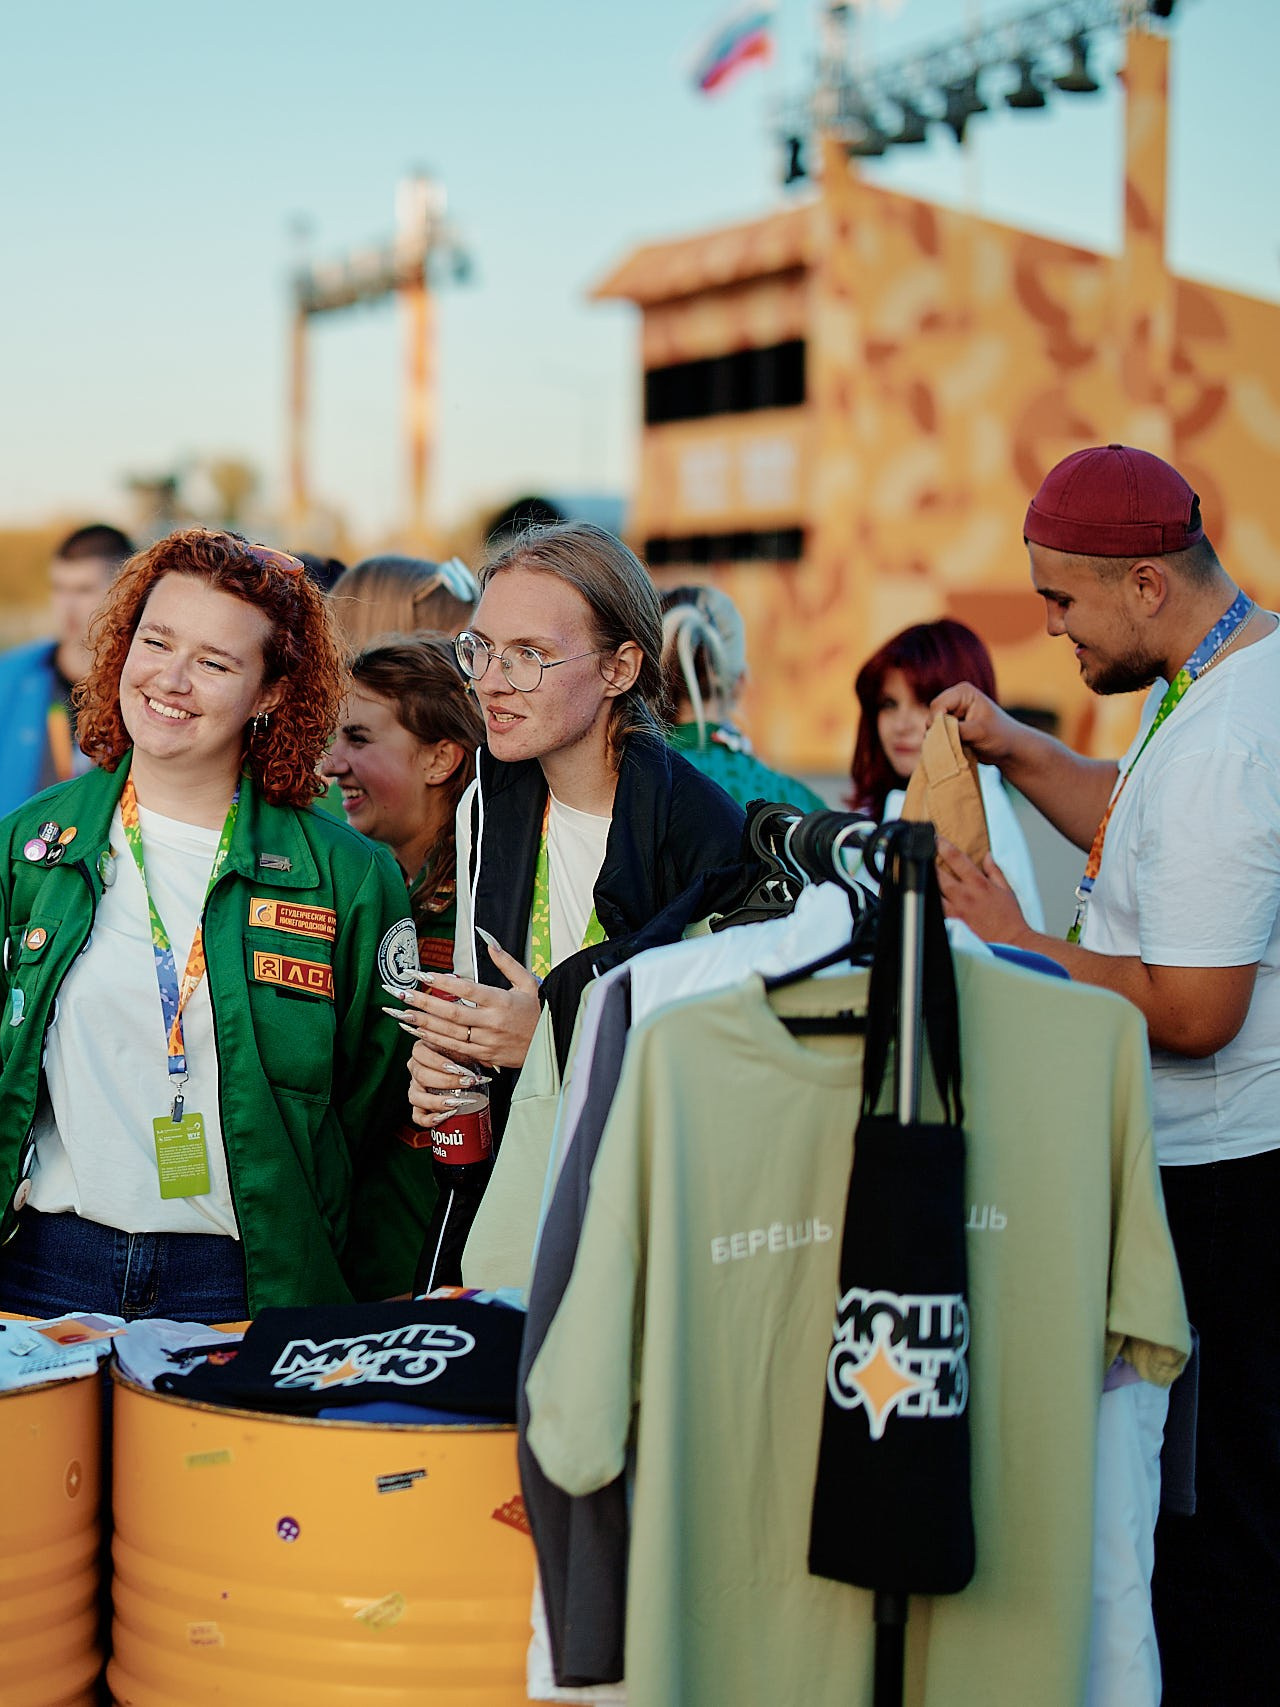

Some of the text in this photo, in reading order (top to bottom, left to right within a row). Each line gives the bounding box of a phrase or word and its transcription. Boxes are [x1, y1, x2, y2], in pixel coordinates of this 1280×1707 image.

[280, 907, 326, 923] СТУДЕНЧЕСКИЕ
[279, 916, 326, 933] НИЖЕГОРОДСКОЙ
[710, 1217, 833, 1264] БЕРЁШЬ
